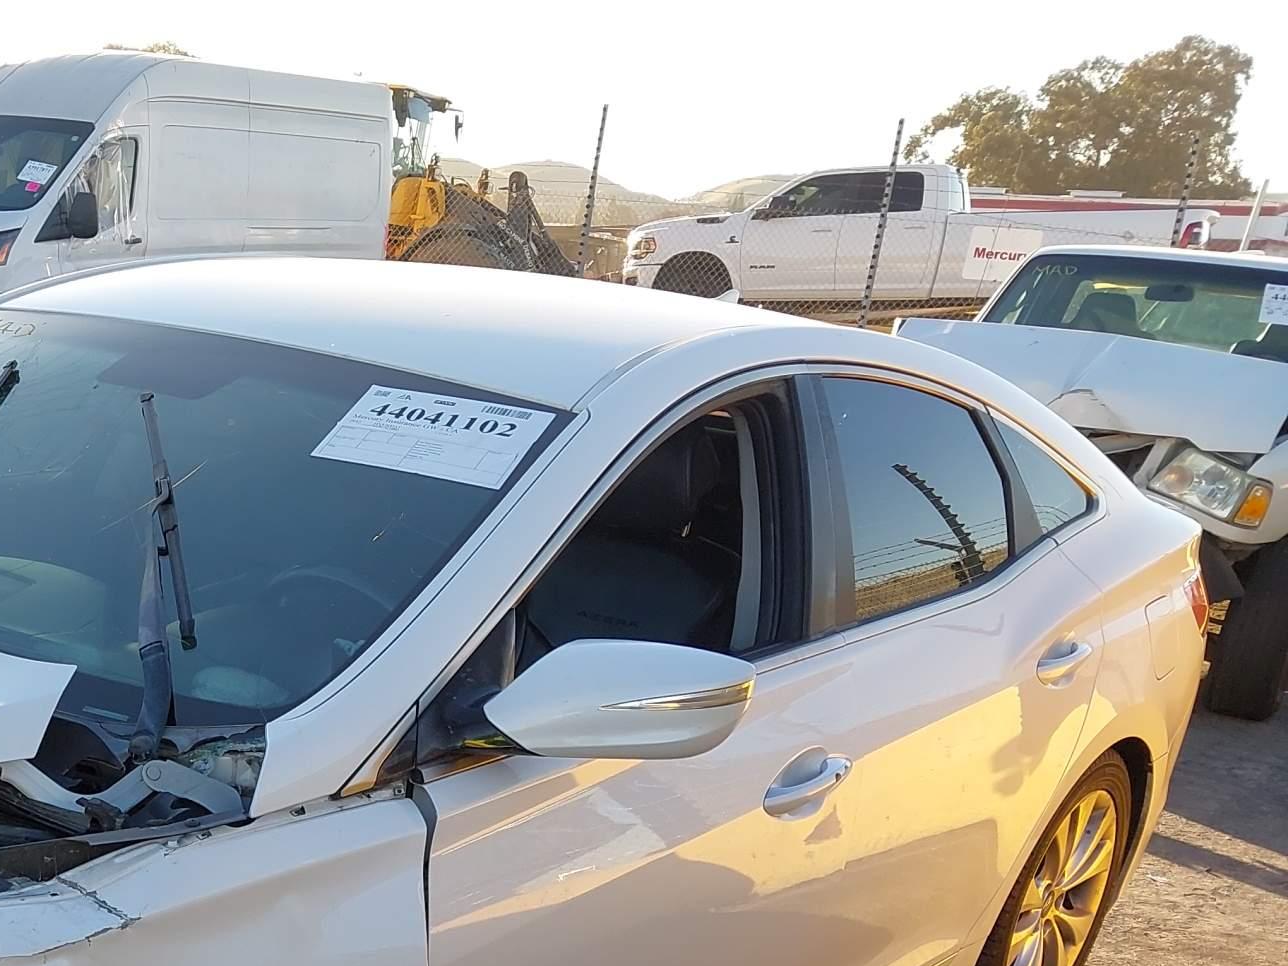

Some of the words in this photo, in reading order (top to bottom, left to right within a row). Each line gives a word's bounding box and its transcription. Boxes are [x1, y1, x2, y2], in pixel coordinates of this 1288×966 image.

[973, 247, 1027, 261] Mercur
[1033, 264, 1078, 276] MAD
[369, 402, 518, 438] 44041102
